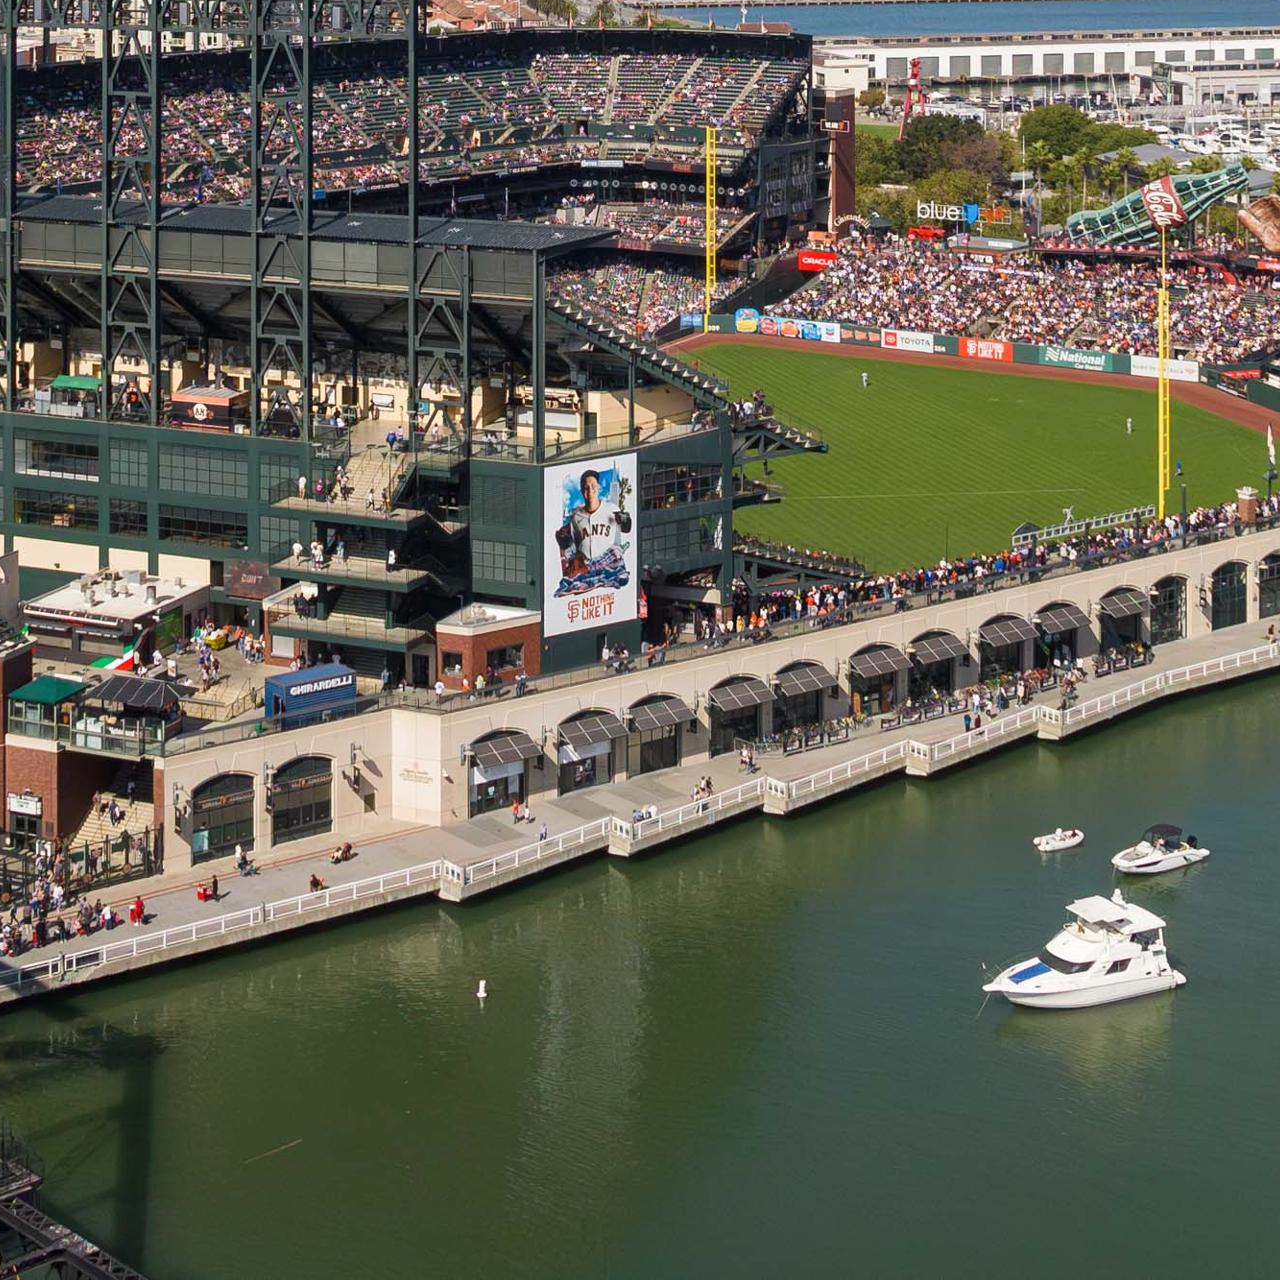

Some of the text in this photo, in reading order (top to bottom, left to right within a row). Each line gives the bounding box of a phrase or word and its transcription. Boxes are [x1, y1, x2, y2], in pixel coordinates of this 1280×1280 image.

[917, 200, 960, 220] blue
[801, 257, 834, 266] ORACLE
[900, 336, 931, 347] TOYOTA
[1059, 350, 1106, 366] National
[582, 592, 614, 609] NOTHING
[582, 602, 614, 621] LIKE IT
[289, 674, 353, 696] GHIRARDELLI
